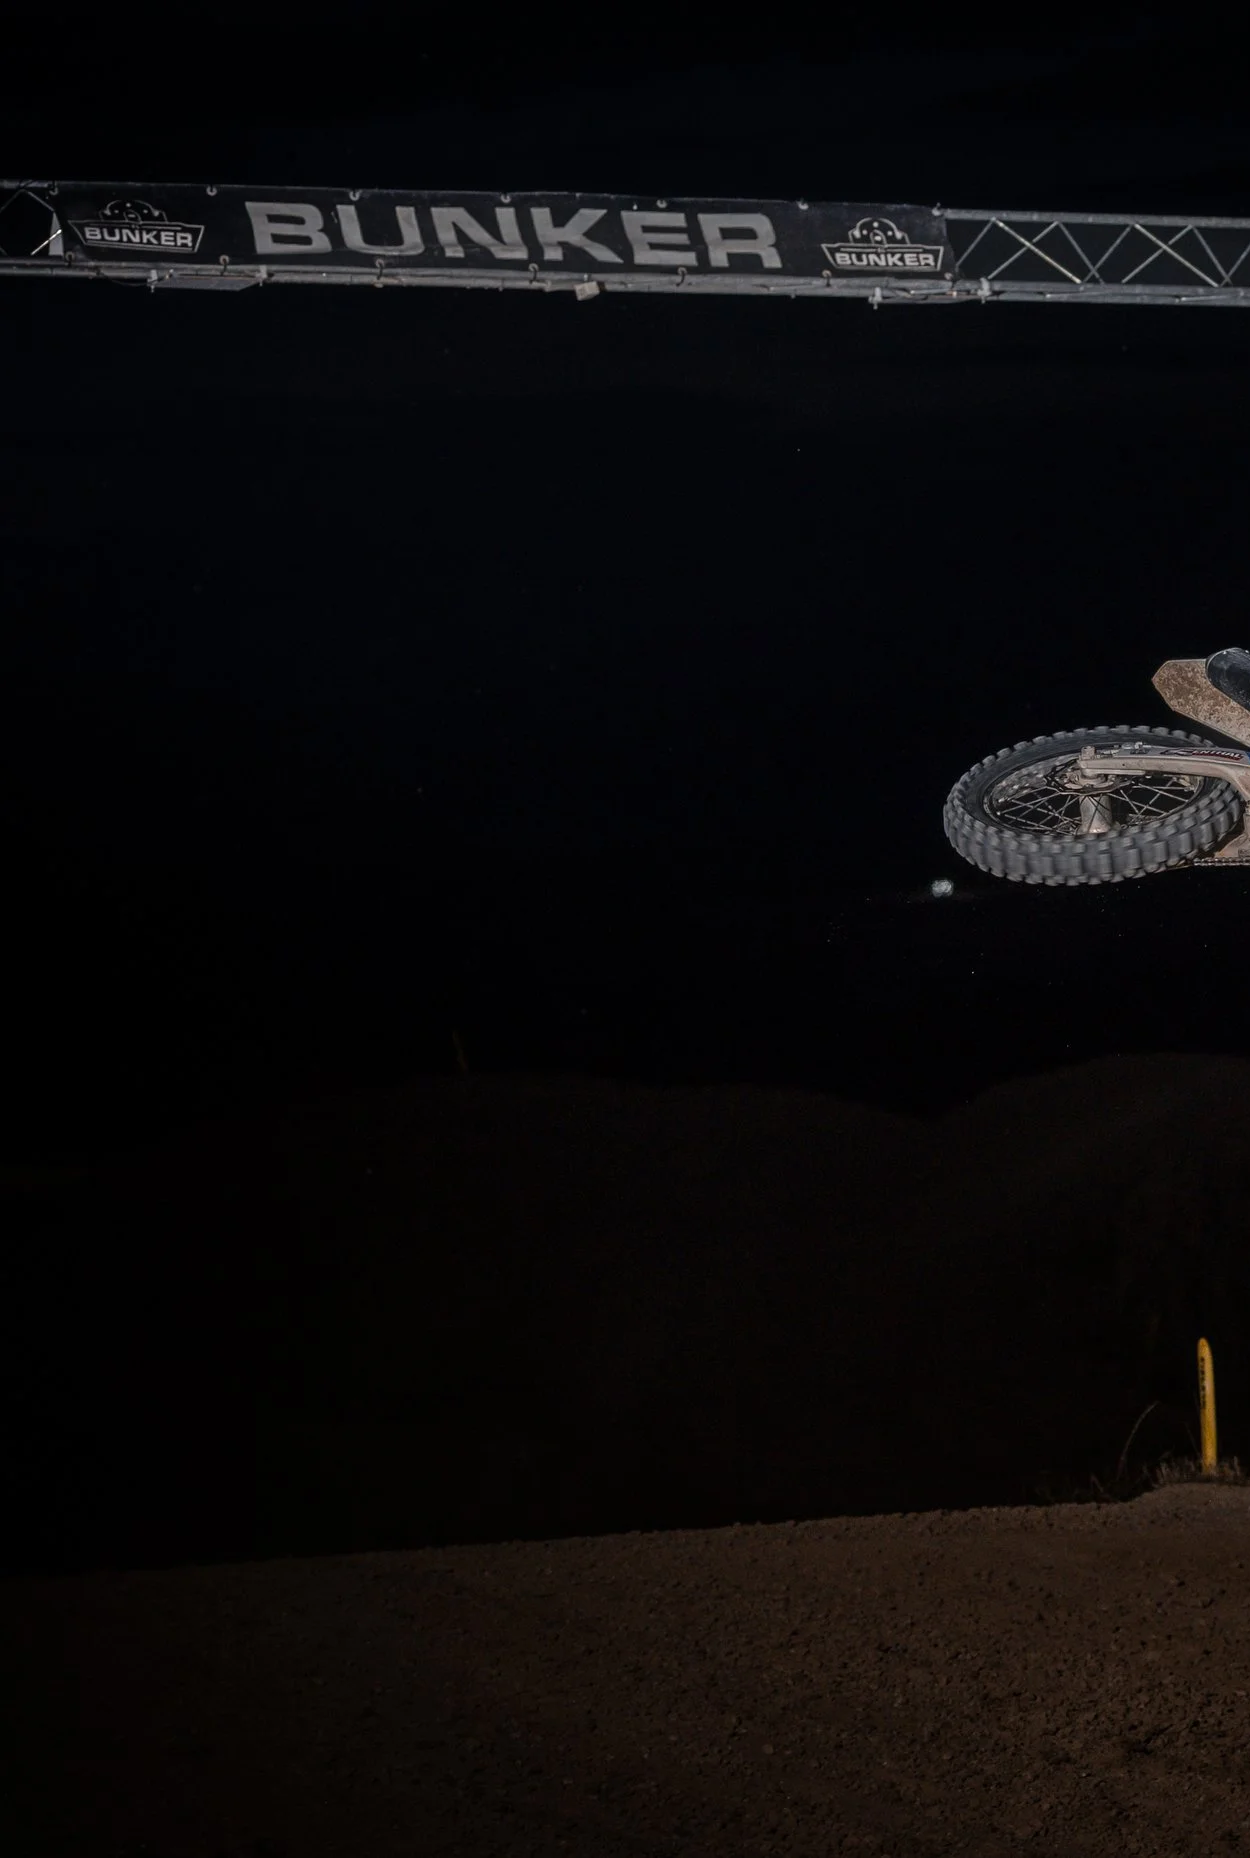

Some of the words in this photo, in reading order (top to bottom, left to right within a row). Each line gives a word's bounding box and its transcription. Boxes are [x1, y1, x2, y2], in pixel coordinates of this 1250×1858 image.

[83, 225, 194, 248] BUNKER
[244, 200, 783, 269] BUNKER
[834, 250, 936, 270] BUNKER
